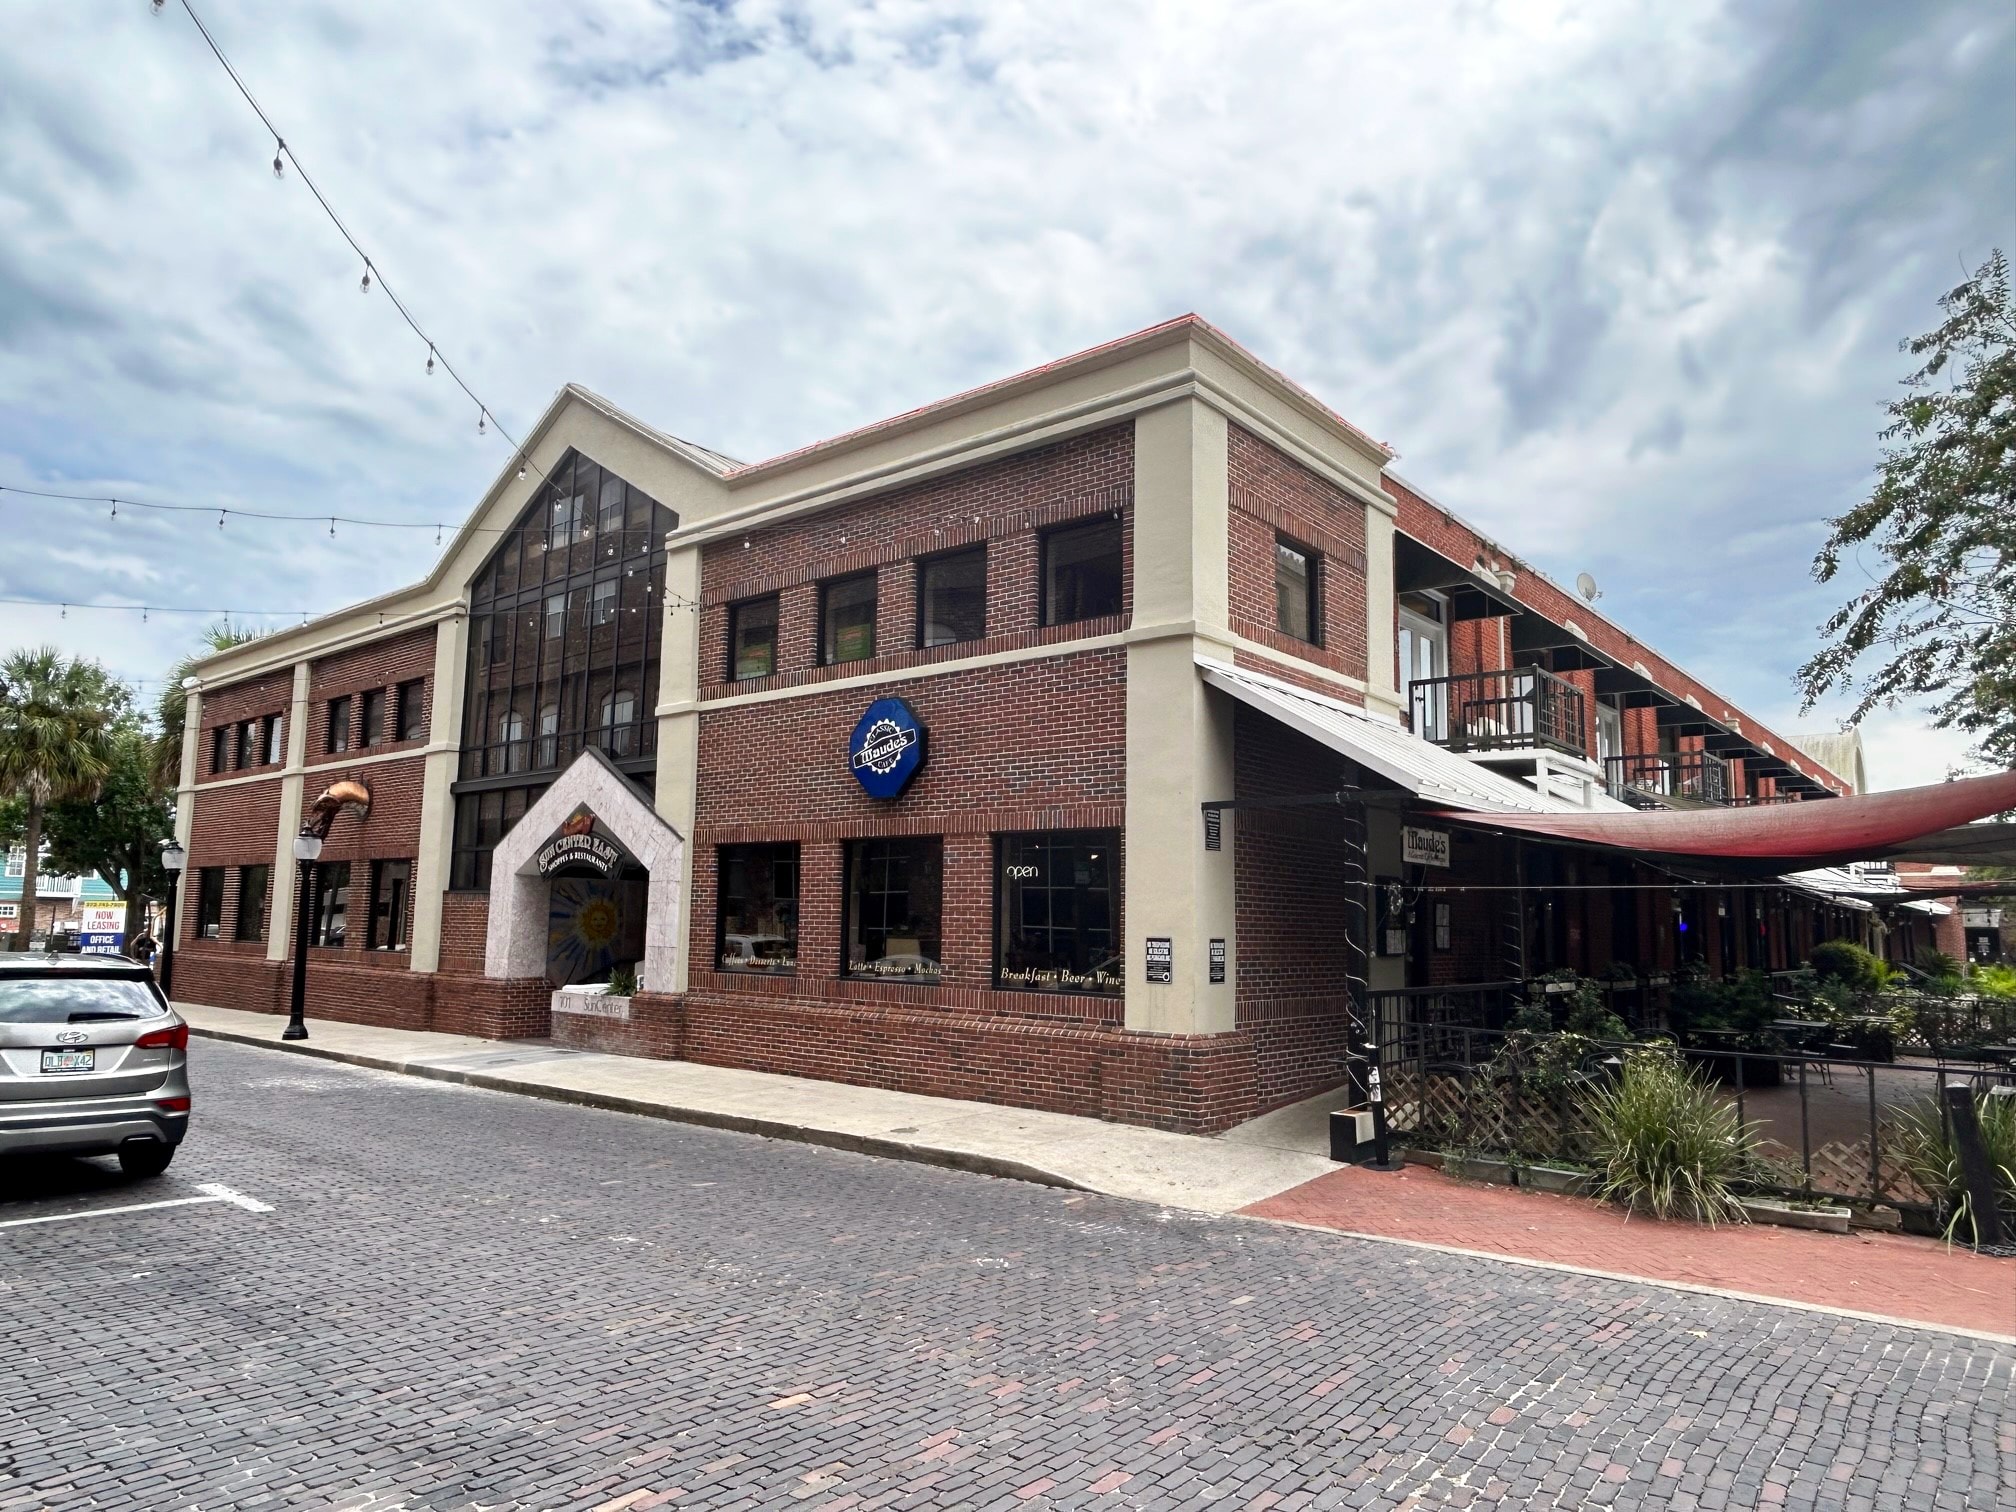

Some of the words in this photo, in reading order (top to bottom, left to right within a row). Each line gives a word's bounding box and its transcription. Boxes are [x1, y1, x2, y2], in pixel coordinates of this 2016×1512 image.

[870, 725, 894, 744] CLASSIC
[1407, 830, 1447, 855] Maude's
[538, 843, 556, 873] SUN
[555, 833, 592, 854] CENTER
[592, 837, 619, 869] EAST
[574, 851, 608, 872] RESTAURANTS
[1006, 865, 1039, 880] open
[95, 910, 114, 920] NOW
[87, 921, 120, 930] LEASING
[90, 935, 115, 944] OFFICE
[81, 945, 97, 954] AND
[97, 945, 121, 955] RETAIL
[874, 961, 906, 975] Espresso
[914, 961, 942, 975] Mochas
[1000, 967, 1050, 983] Breakfast
[1061, 969, 1086, 983] Beer
